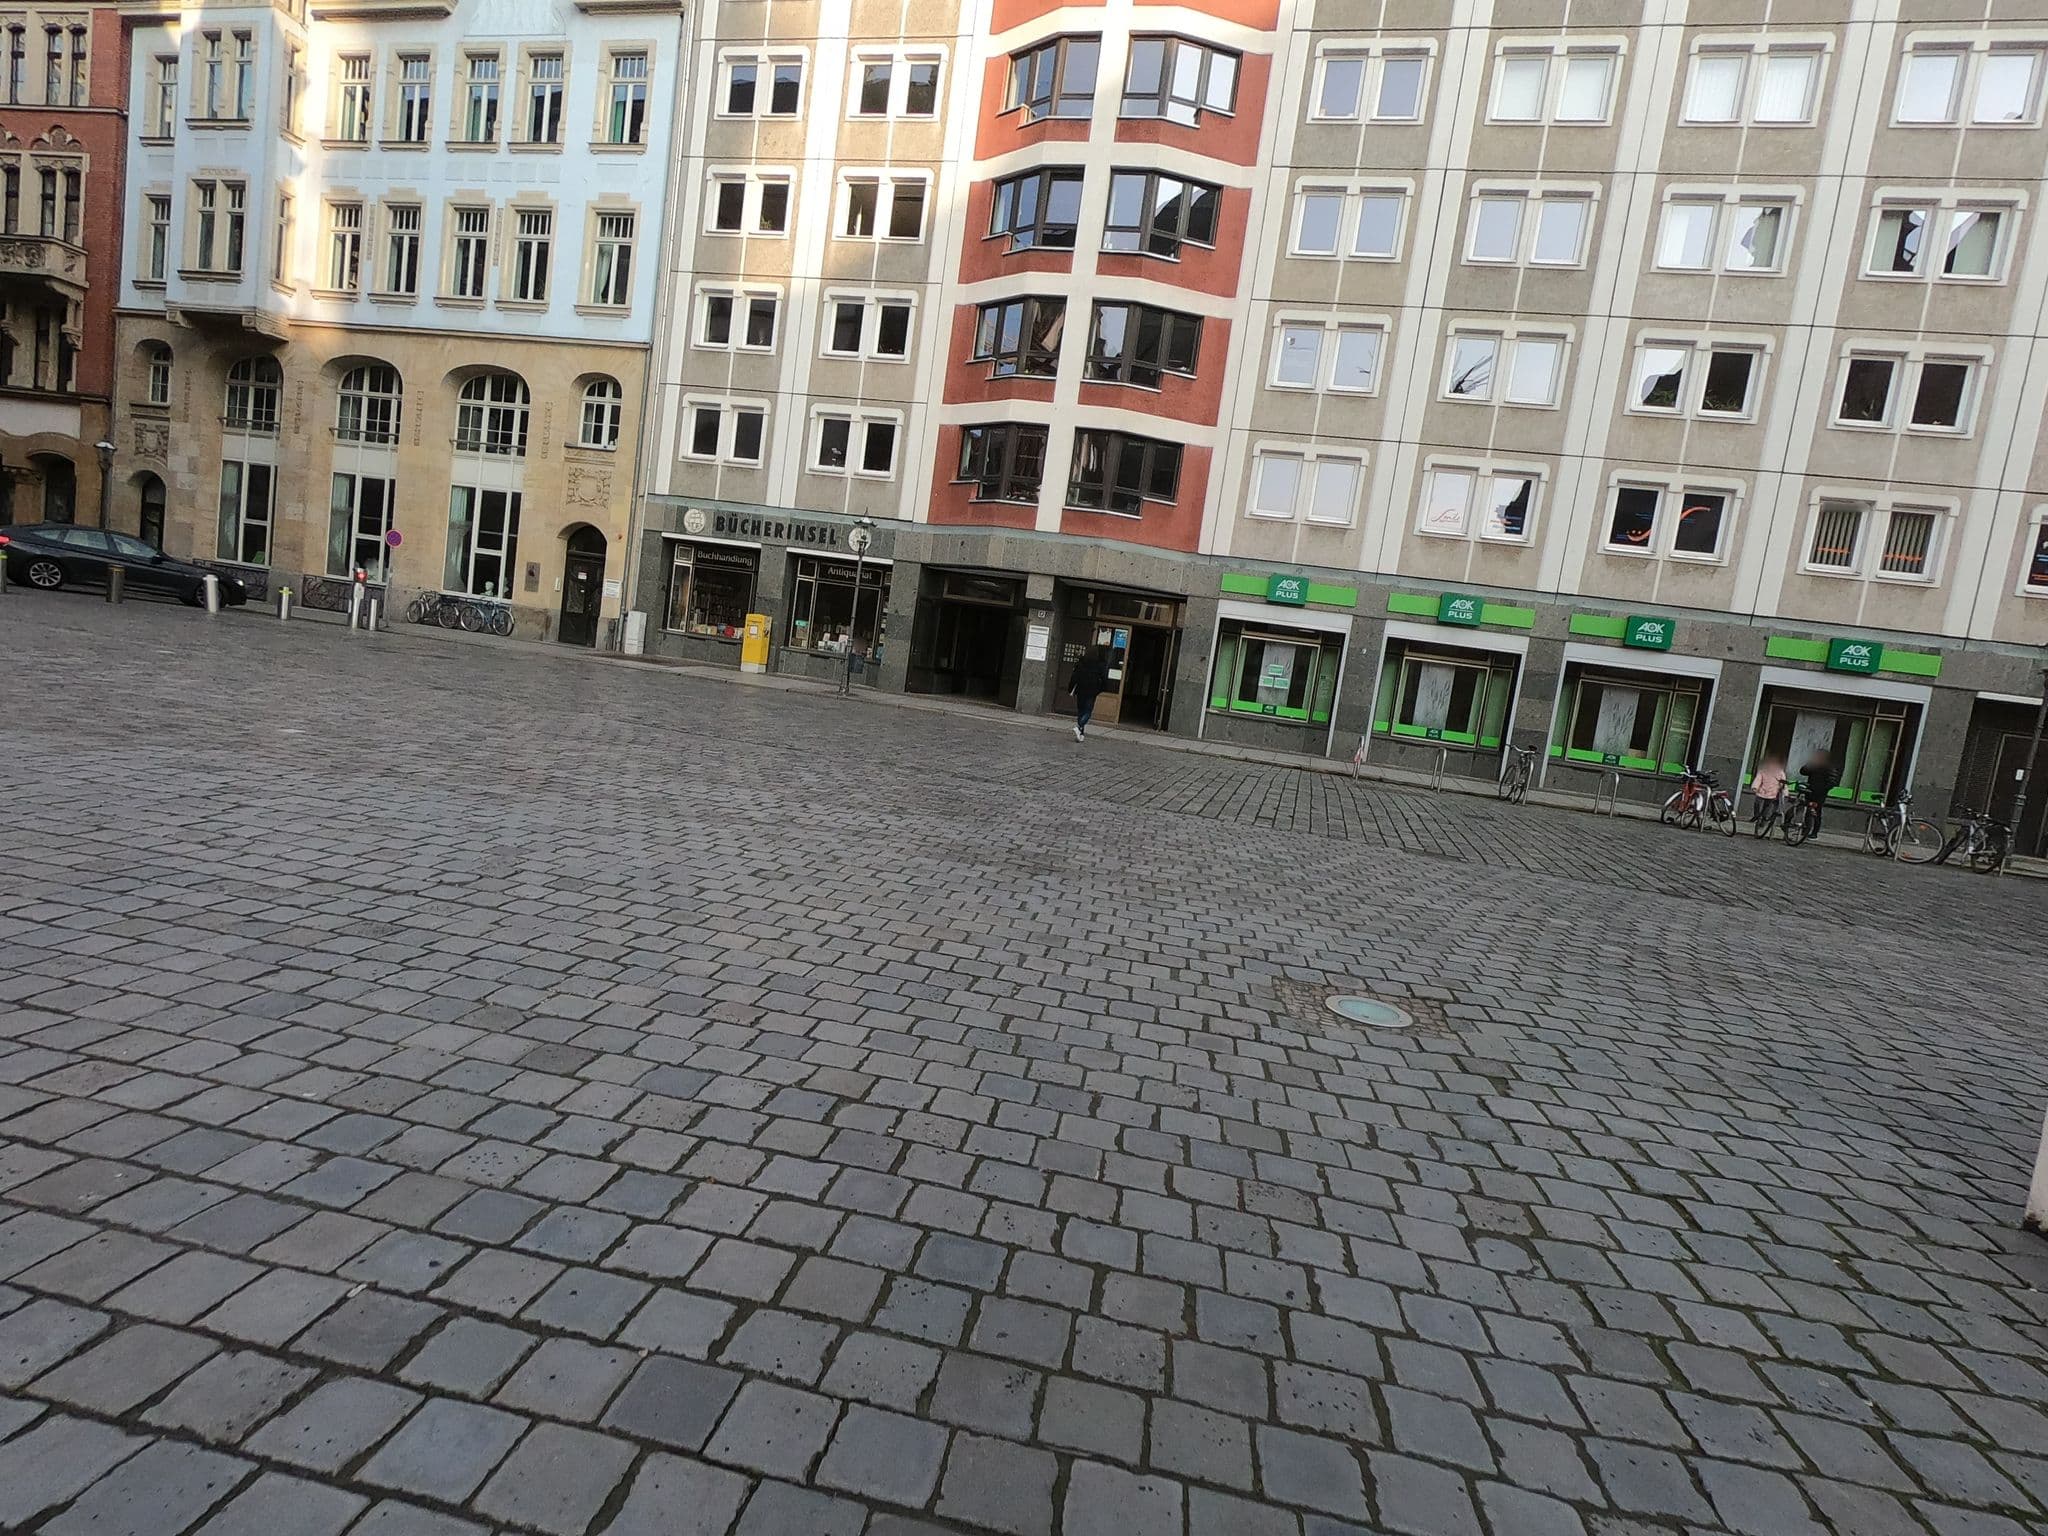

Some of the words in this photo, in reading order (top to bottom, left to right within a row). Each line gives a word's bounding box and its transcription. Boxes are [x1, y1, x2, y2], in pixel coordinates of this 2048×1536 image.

[715, 512, 837, 545] BÜCHERINSEL
[697, 550, 753, 567] Buchhandlung
[827, 566, 873, 580] Antiquaiat
[1277, 579, 1301, 590] AOK
[1275, 590, 1299, 600] PLUS
[1449, 599, 1475, 611] AOK
[1447, 610, 1473, 620] PLUS
[1637, 621, 1666, 634] AOK
[1635, 634, 1663, 644] PLUS
[1841, 644, 1873, 657] AOK
[1839, 656, 1870, 667] PLUS
